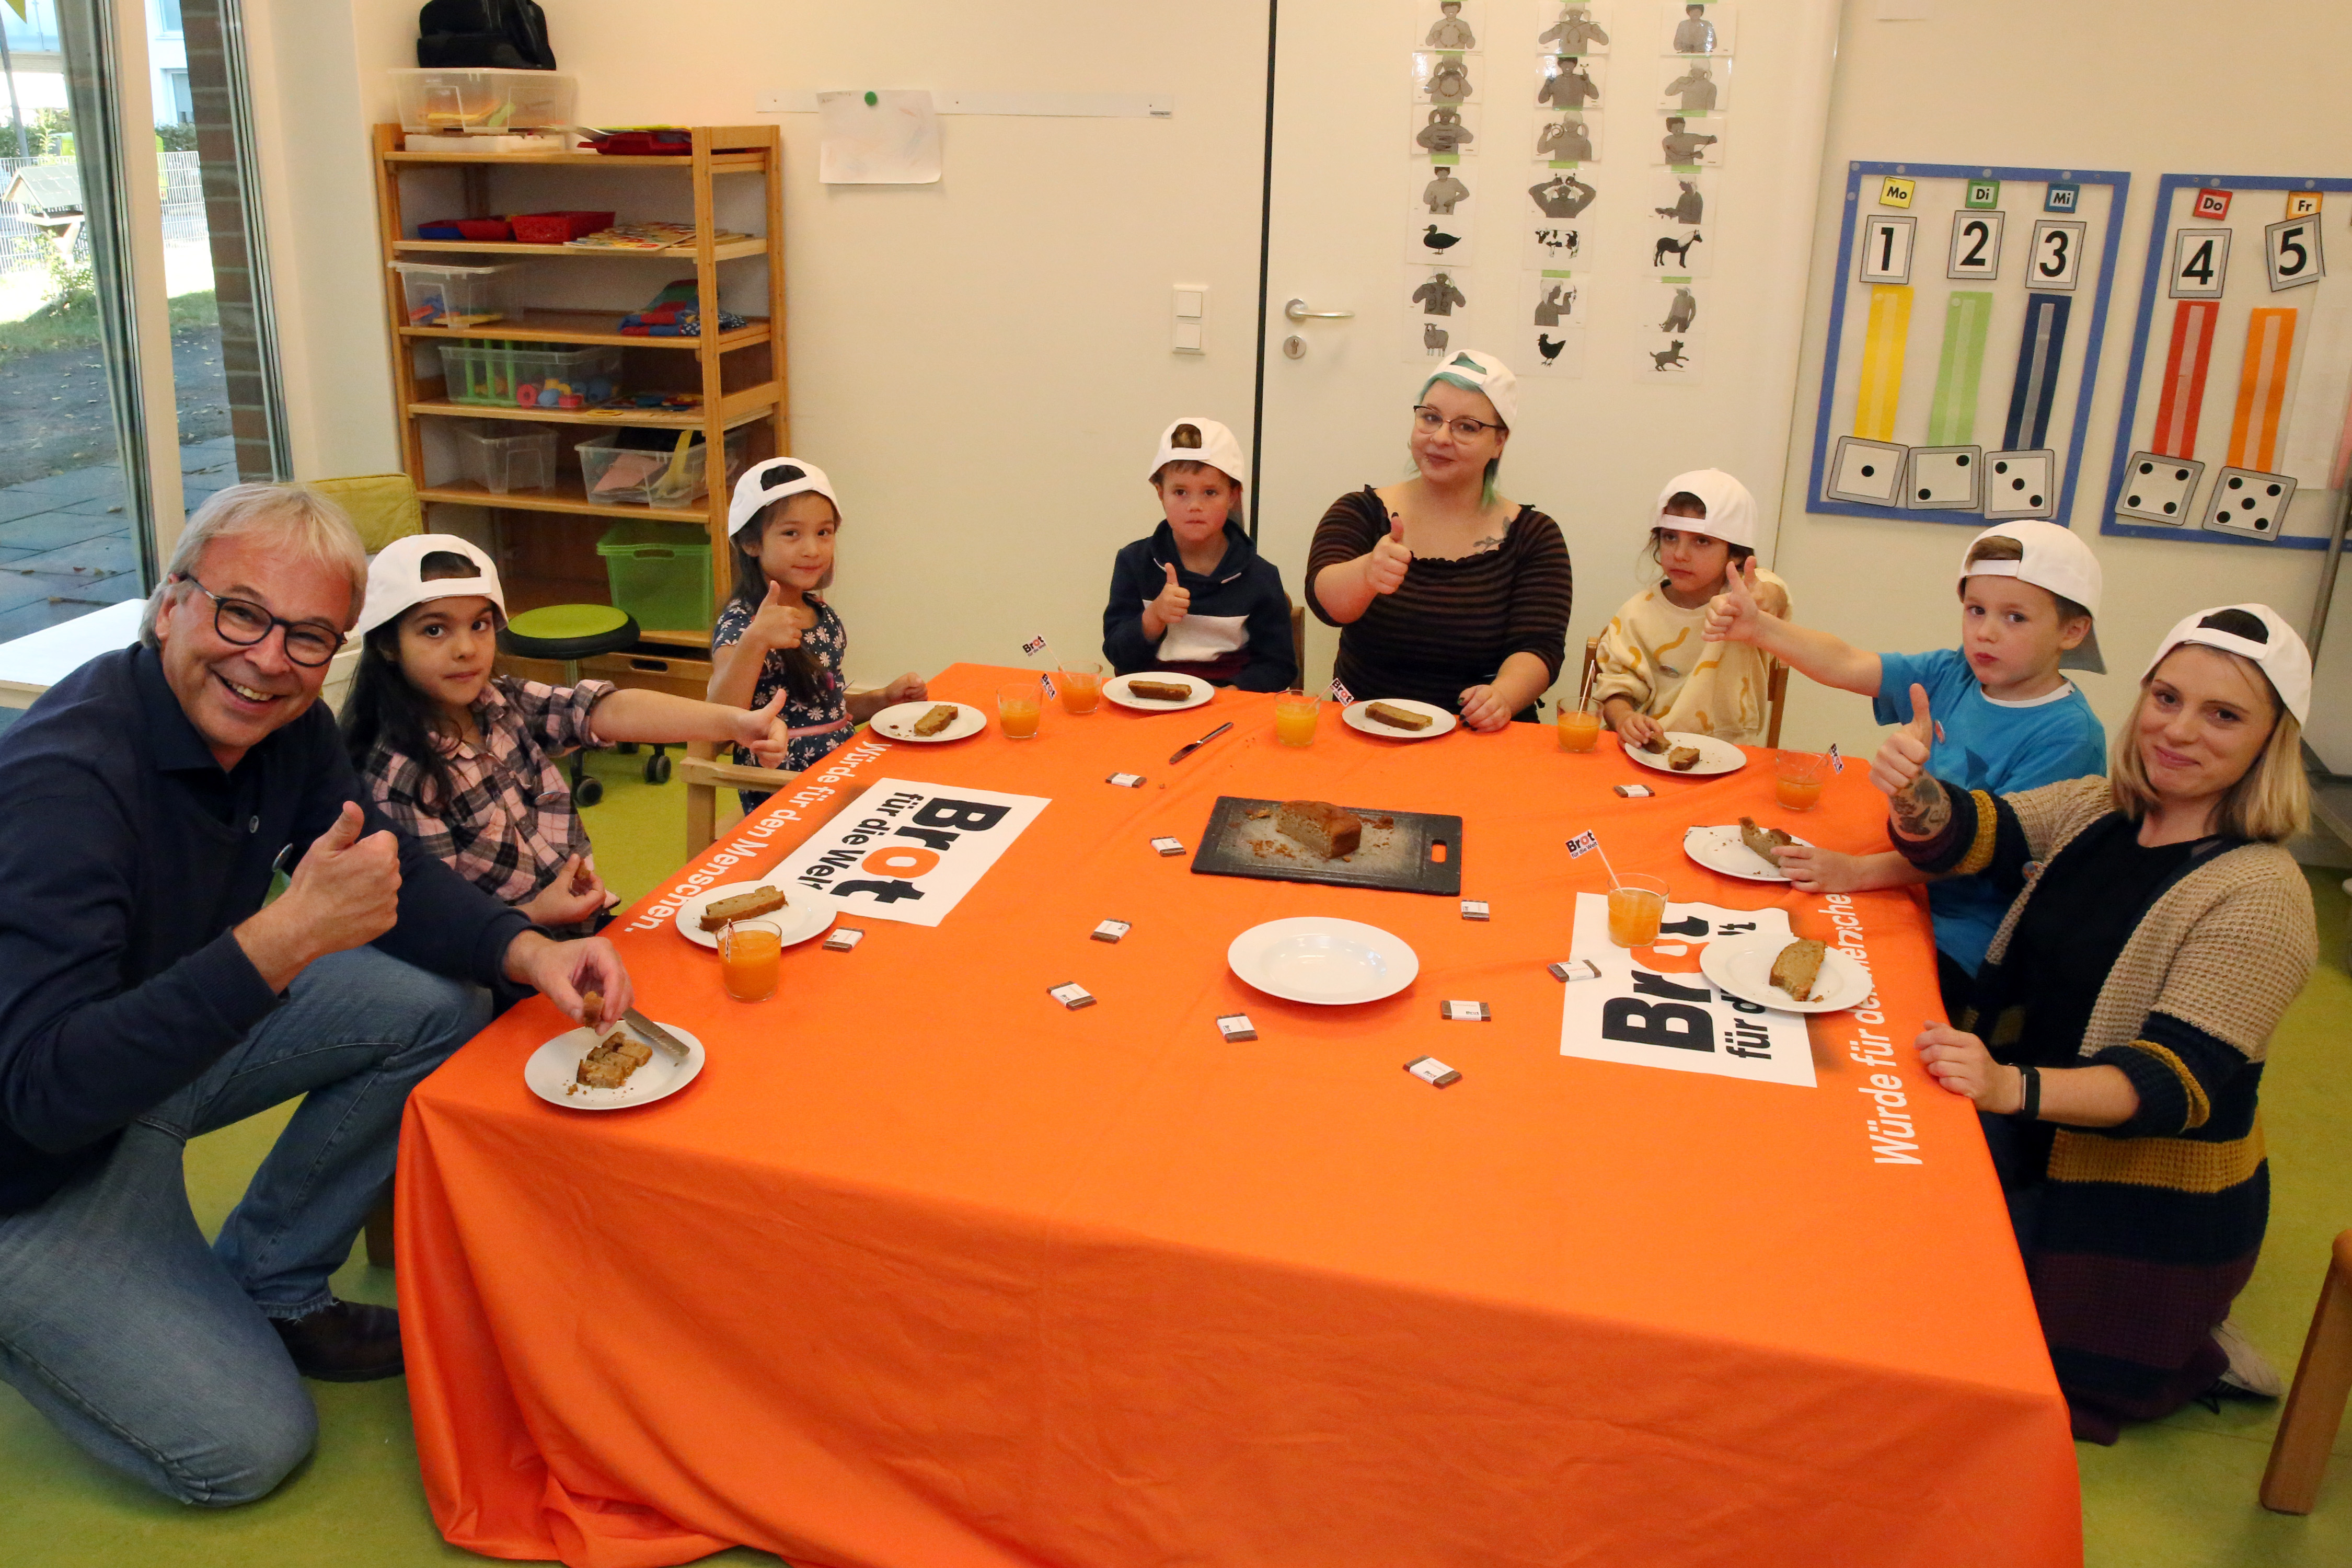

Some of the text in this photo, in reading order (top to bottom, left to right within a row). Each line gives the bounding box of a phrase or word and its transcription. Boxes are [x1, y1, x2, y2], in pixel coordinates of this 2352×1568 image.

[1886, 186, 1907, 200] Mo
[1976, 188, 1990, 200] Di
[2053, 192, 2071, 205] Mi
[2203, 197, 2223, 211] Do
[2298, 200, 2312, 212] Fr
[1880, 226, 1896, 272] 1
[1958, 221, 1989, 266] 2
[2039, 230, 2069, 277] 3
[2278, 227, 2308, 276] 5
[2181, 239, 2214, 285] 4
[1022, 635, 1044, 653] Brot
[1042, 673, 1055, 698] Brot
[1332, 679, 1352, 703] Brot
[816, 740, 892, 783] Würde
[794, 785, 836, 808] für
[875, 791, 925, 817] für
[746, 809, 802, 838] den
[841, 817, 891, 845] die
[829, 797, 1012, 904] Brot
[1565, 831, 1595, 853] Brot
[1845, 983, 1885, 1024] de
[1724, 1018, 1772, 1060] für
[1849, 1028, 1897, 1067] für
[1858, 1073, 1923, 1165] Würde
